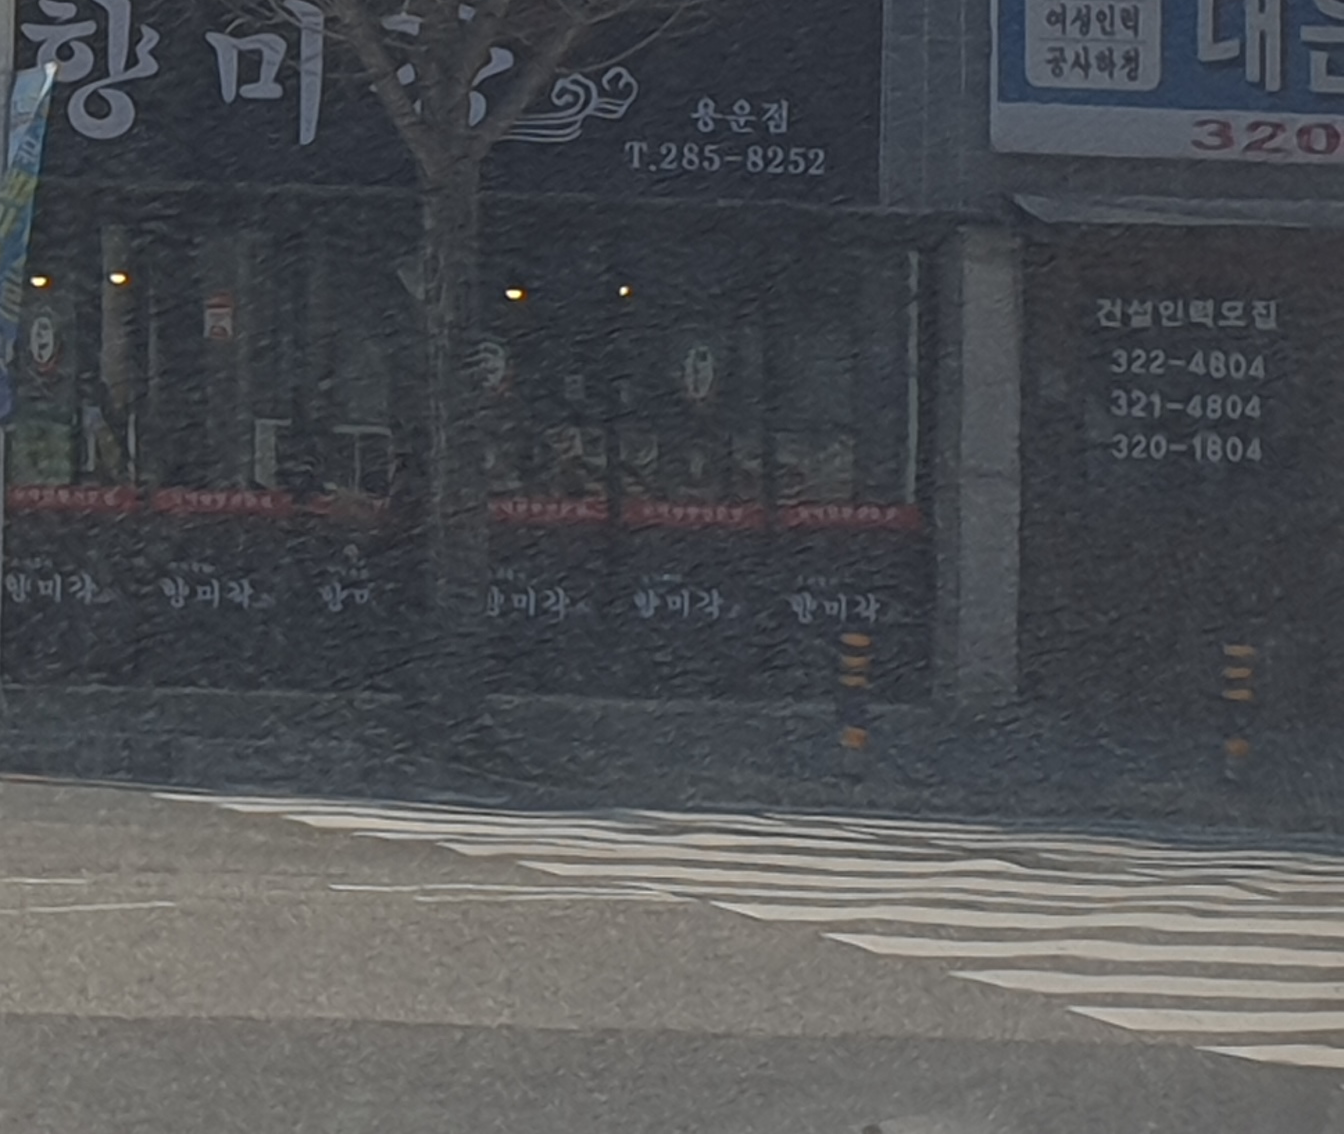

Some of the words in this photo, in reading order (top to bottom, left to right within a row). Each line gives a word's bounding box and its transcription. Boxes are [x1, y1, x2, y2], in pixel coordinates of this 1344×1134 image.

[1045, 2, 1140, 38] 여성인력
[690, 98, 791, 135] 용운점
[624, 141, 826, 176] T.285-8252
[1111, 349, 1265, 379] 322-4804
[1110, 389, 1262, 419] 321-4804
[1111, 433, 1263, 463] 320-1804
